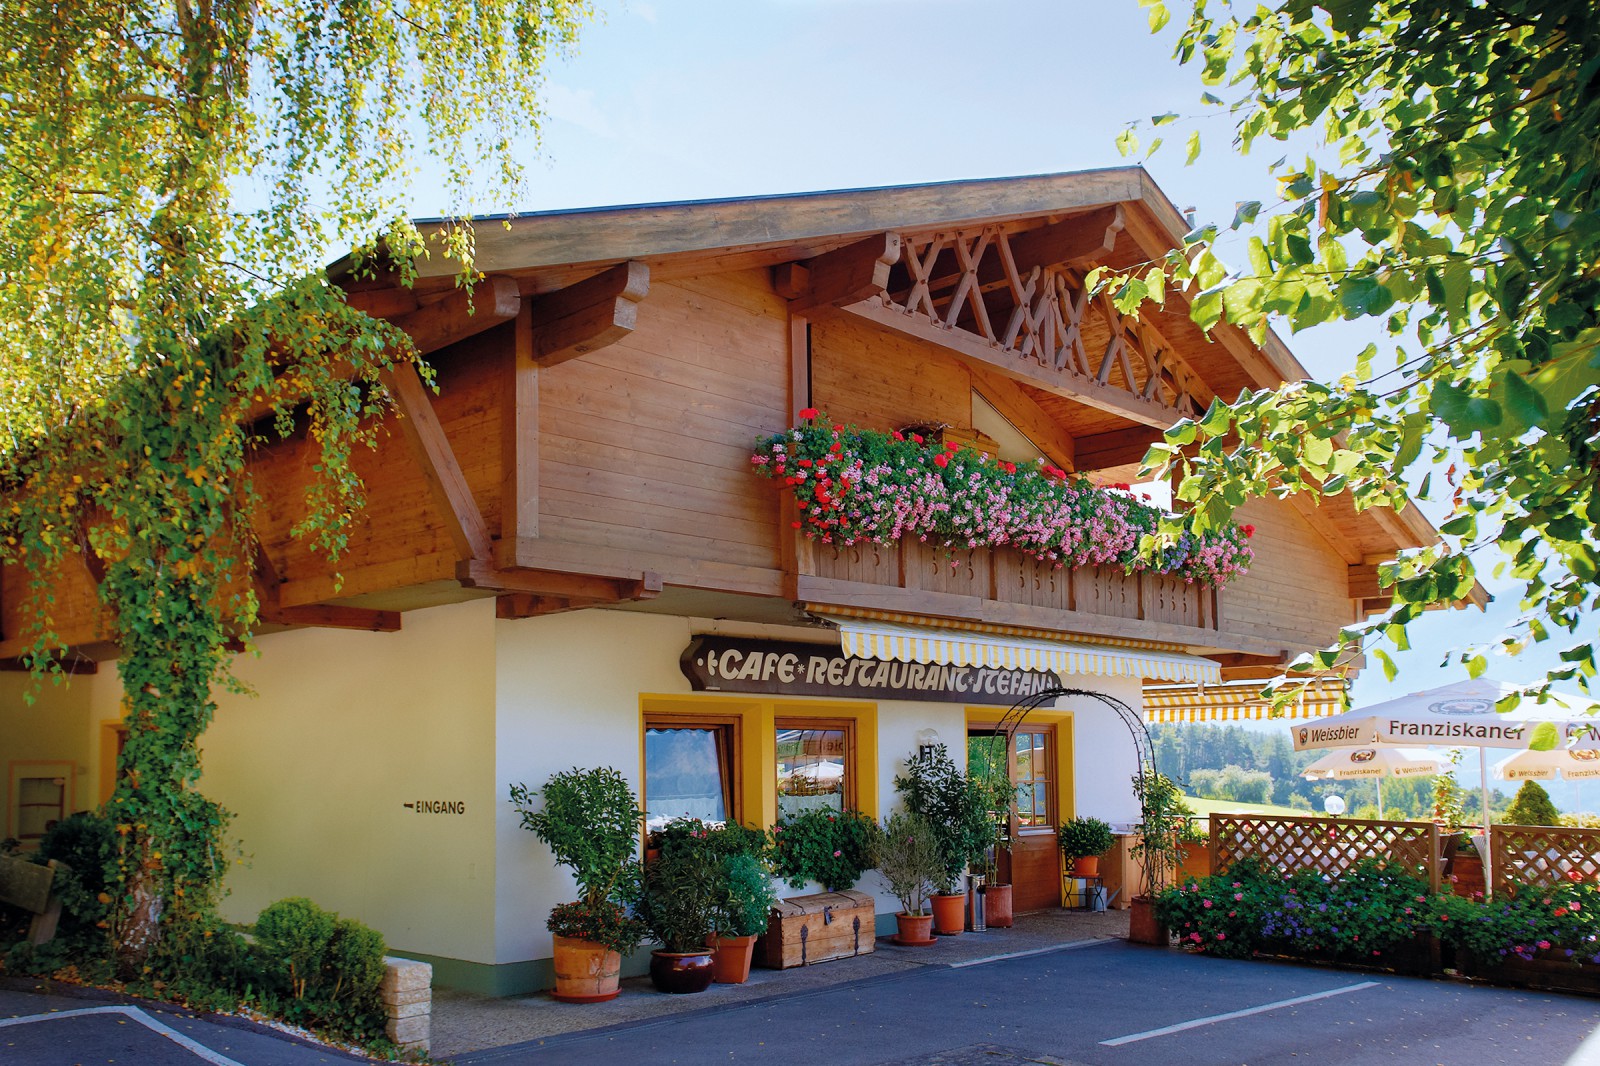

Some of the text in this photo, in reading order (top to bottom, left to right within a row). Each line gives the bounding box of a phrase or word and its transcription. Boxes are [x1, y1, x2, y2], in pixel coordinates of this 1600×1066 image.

[718, 649, 1047, 696] CAFE RESTAURANT STEFAN
[1311, 726, 1360, 742] Weissbier
[1389, 720, 1525, 740] Franziskaner
[1340, 768, 1382, 776] Franziskaner
[416, 801, 465, 814] EINGANG
